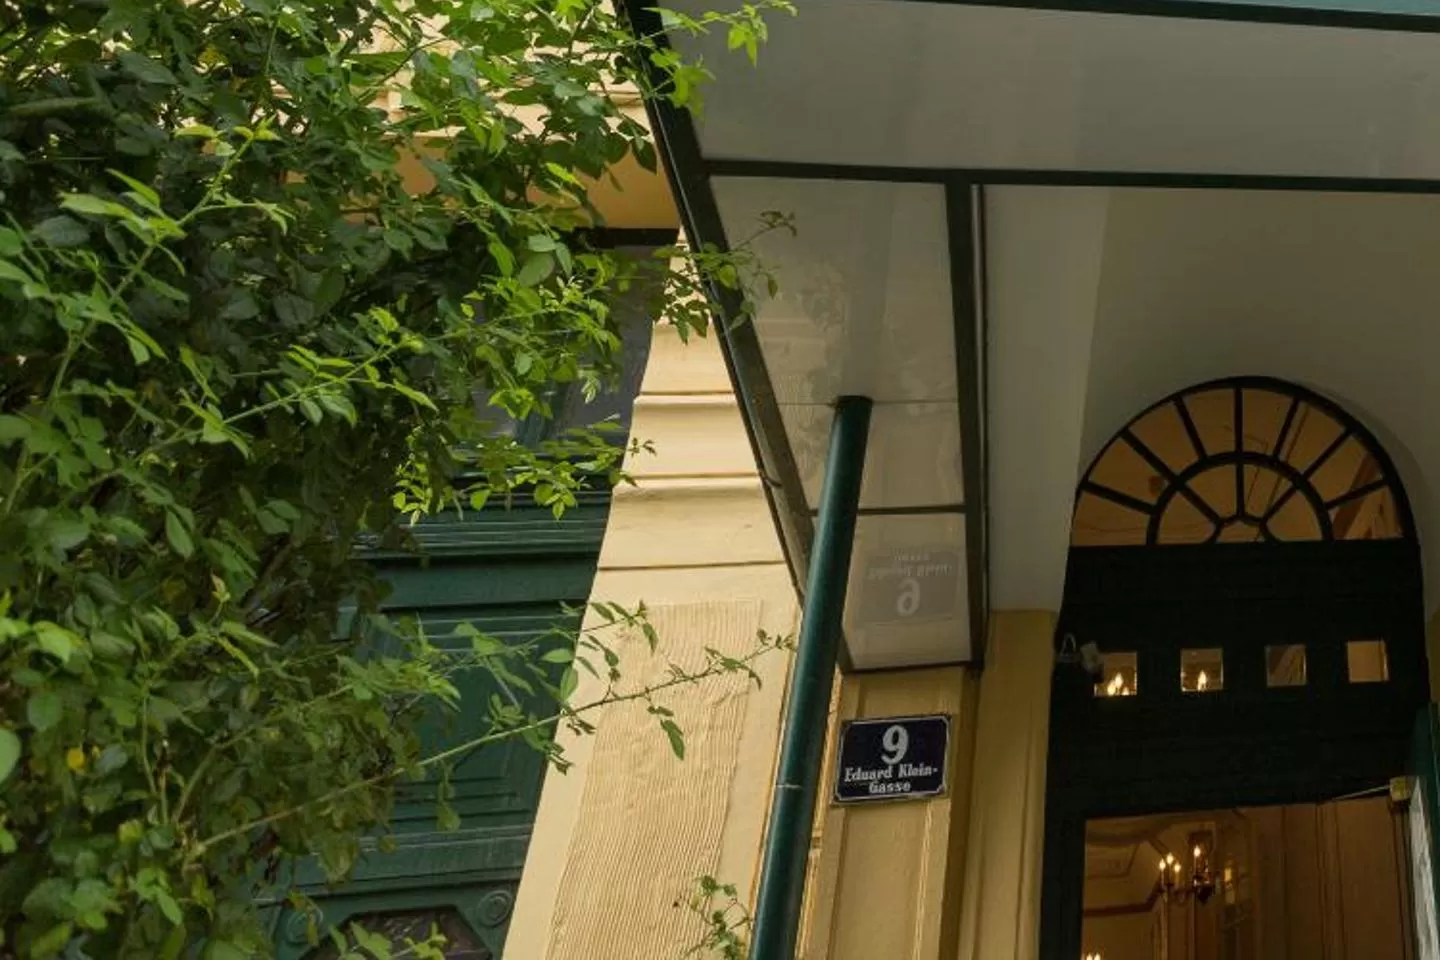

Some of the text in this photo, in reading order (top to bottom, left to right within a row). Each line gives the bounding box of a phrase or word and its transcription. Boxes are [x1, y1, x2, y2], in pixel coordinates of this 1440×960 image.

[881, 724, 909, 765] 9
[844, 766, 893, 782] Eduard
[868, 781, 911, 794] Gasse
